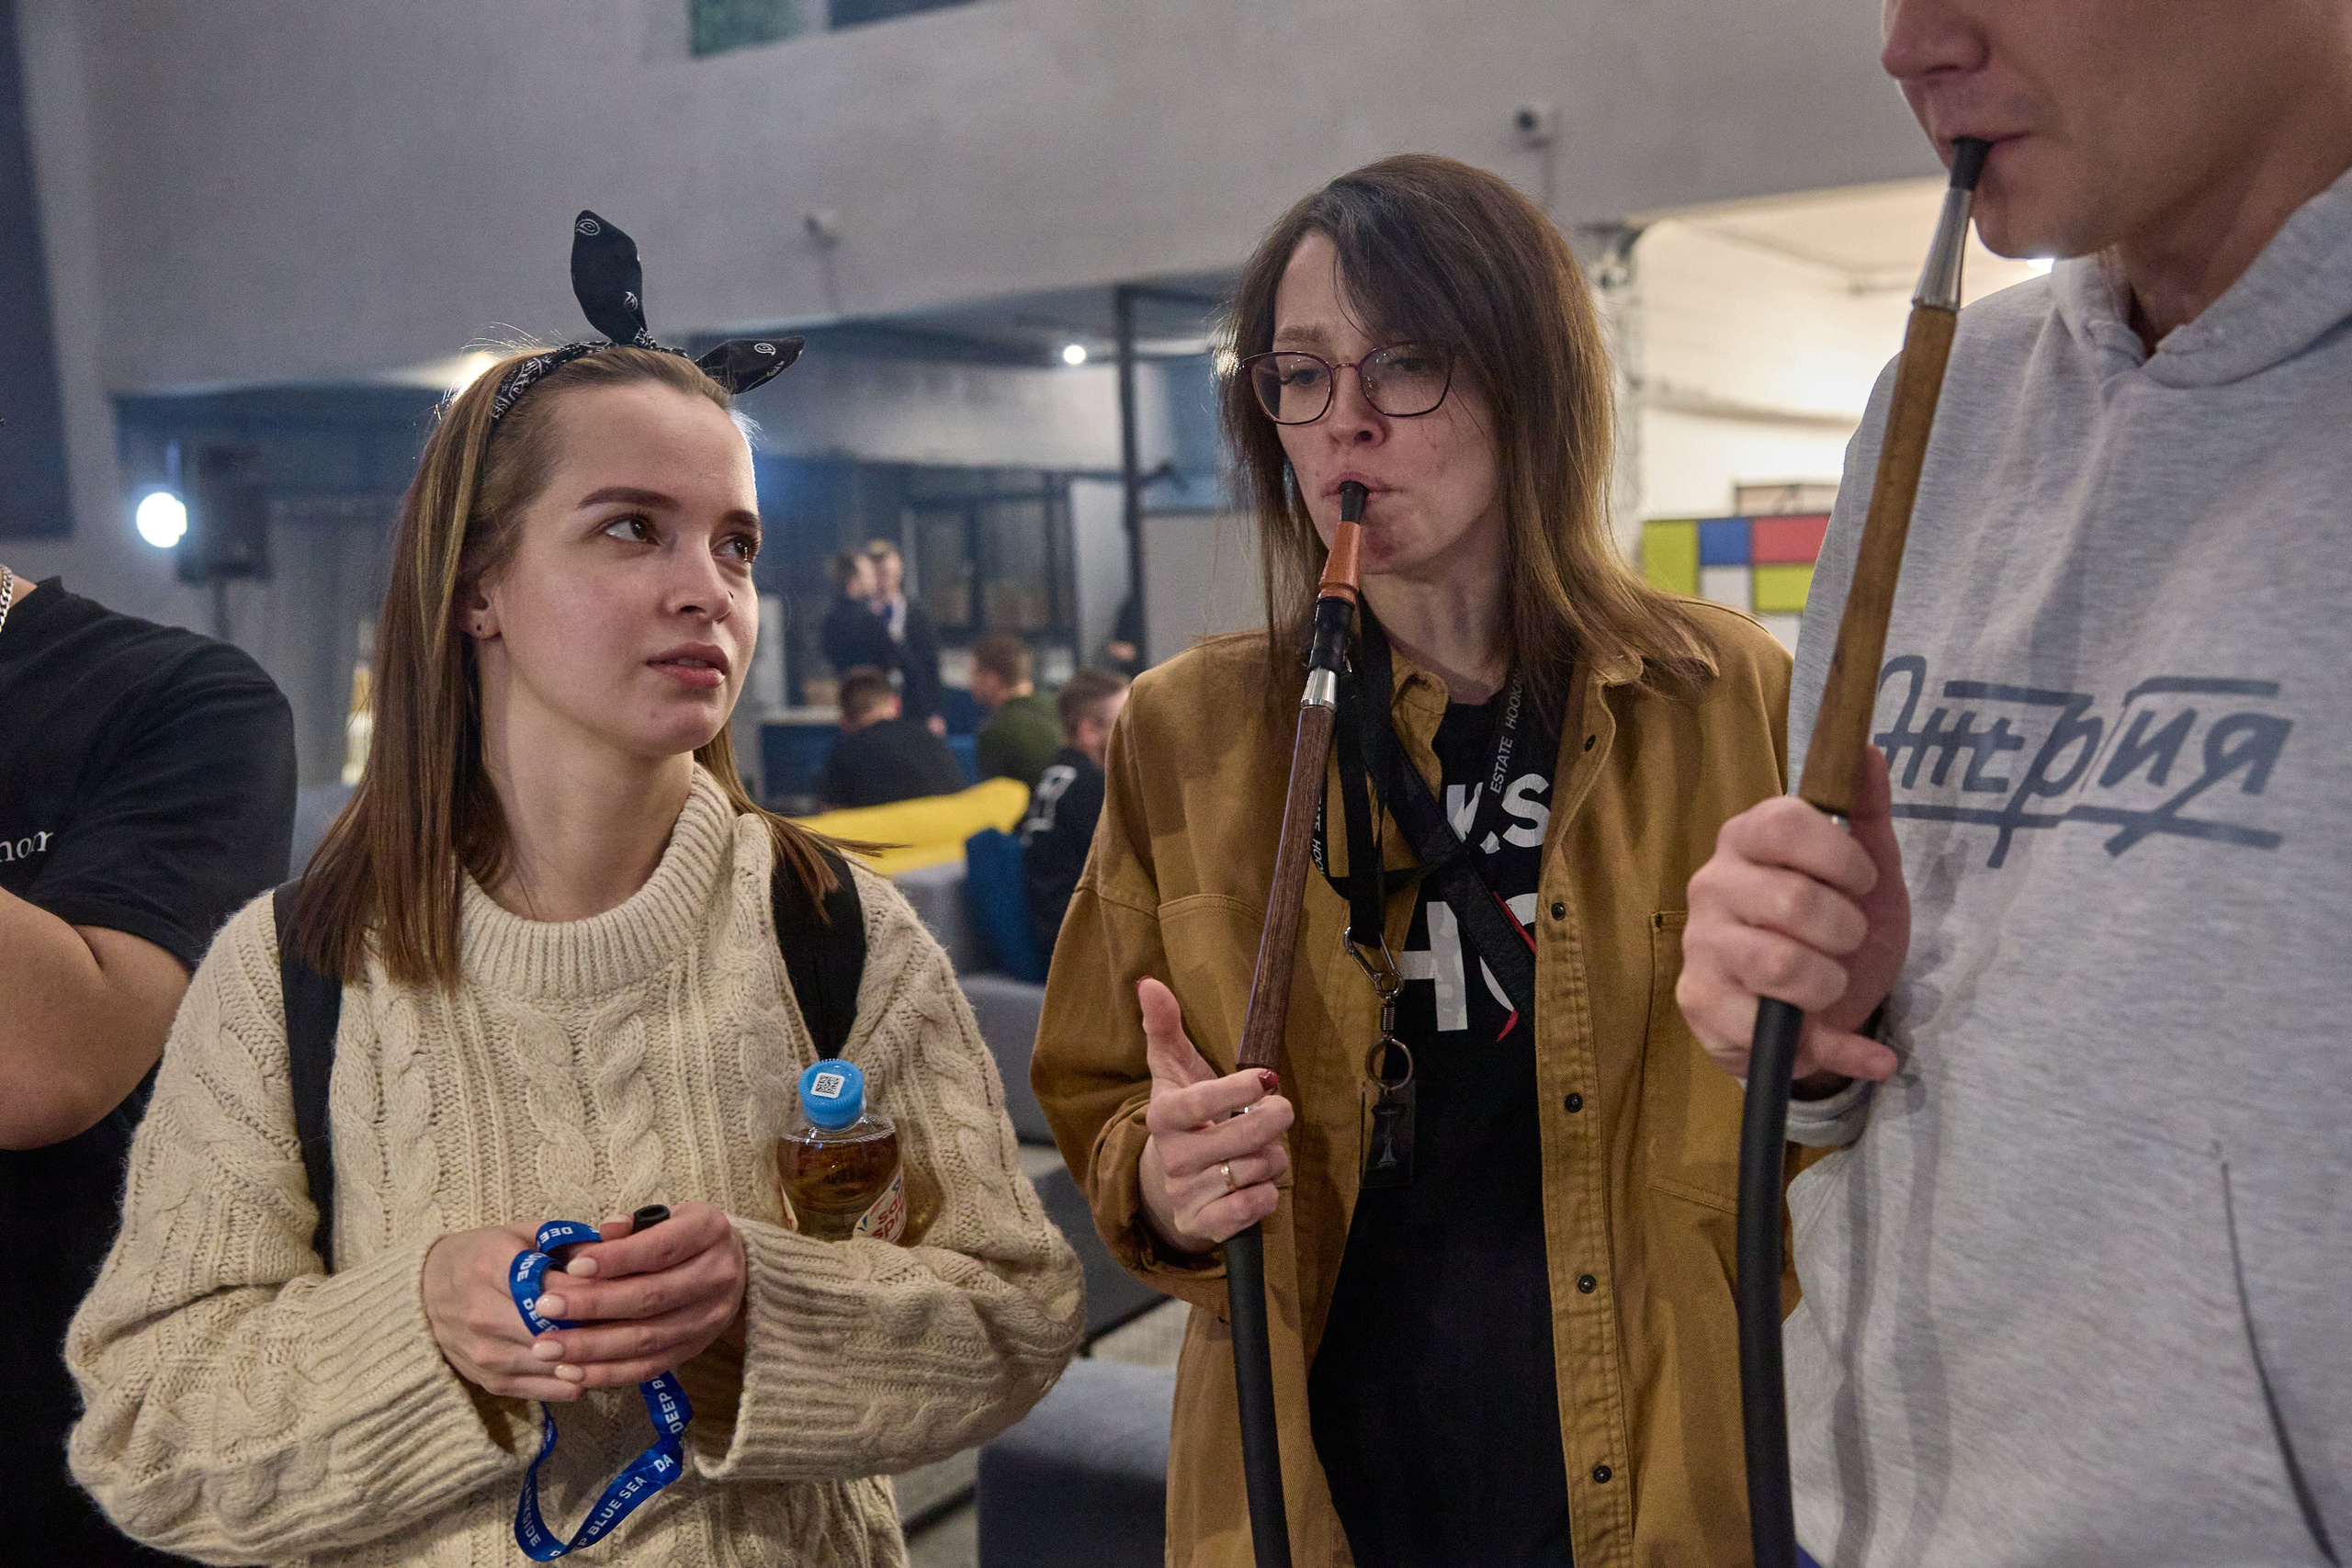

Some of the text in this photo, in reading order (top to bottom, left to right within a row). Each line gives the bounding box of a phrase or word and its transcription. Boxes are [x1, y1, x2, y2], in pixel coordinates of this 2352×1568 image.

[1489, 736, 1513, 795] ESTATE
[659, 1392, 684, 1434] DEEP
[587, 1499, 623, 1536] BLUE
[618, 1475, 648, 1499] SEA
